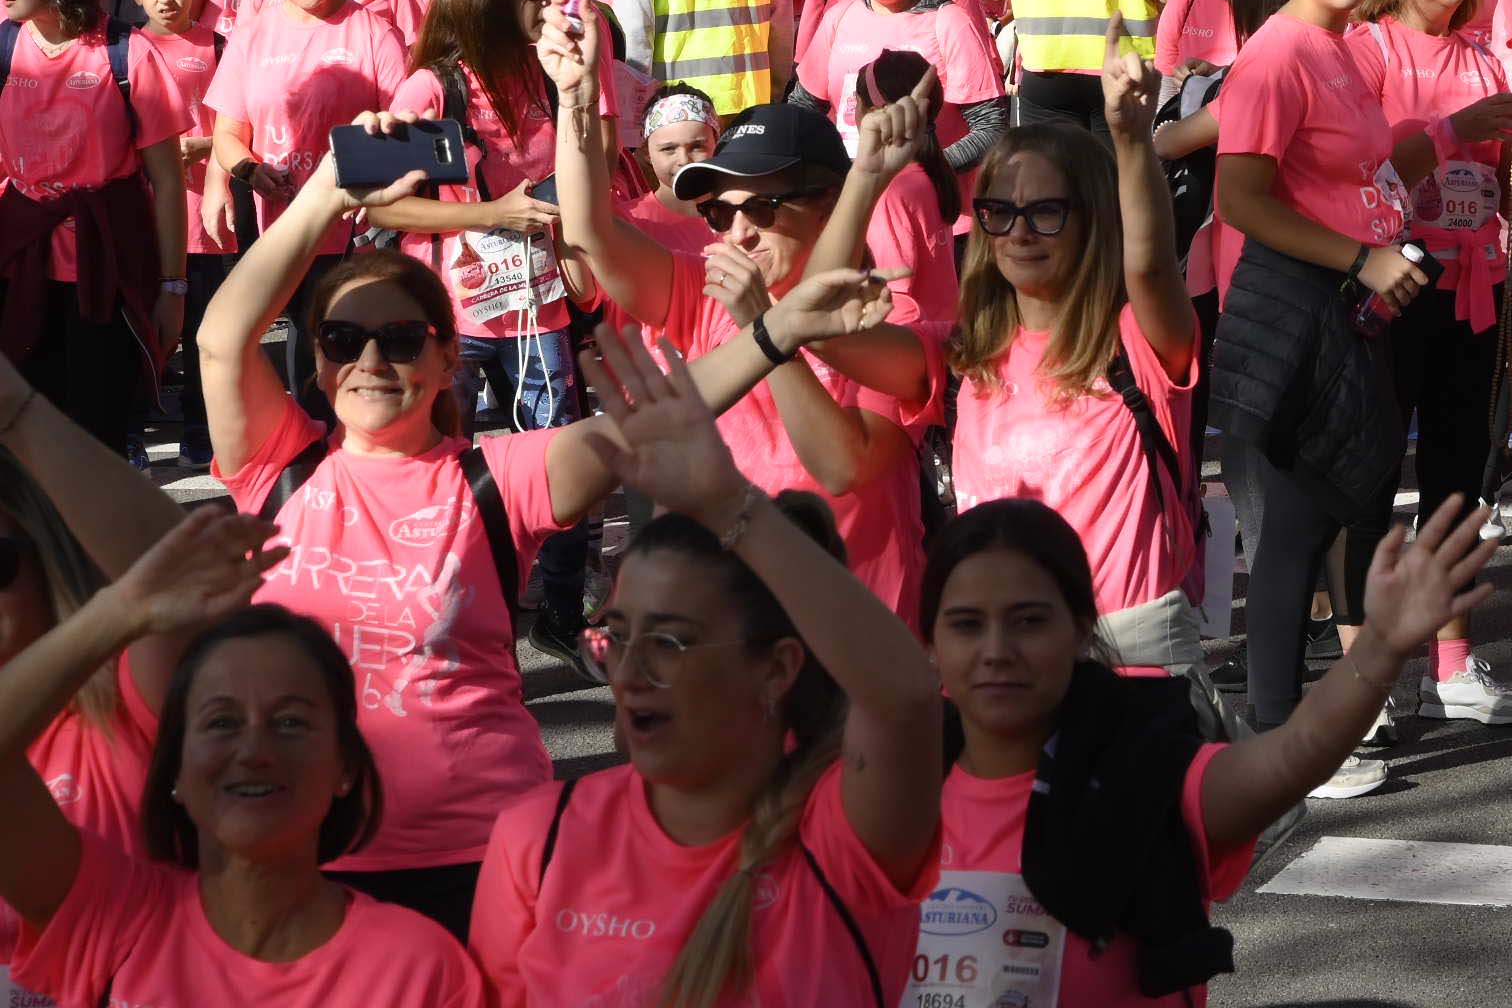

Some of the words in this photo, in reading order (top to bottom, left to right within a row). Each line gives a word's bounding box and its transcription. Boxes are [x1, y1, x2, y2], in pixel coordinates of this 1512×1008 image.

[262, 124, 288, 146] TU
[1446, 199, 1478, 215] 016
[1448, 217, 1473, 228] 24000
[487, 253, 524, 276] 016
[494, 272, 524, 286] 13540
[350, 600, 380, 625] DE
[384, 605, 417, 629] LA
[556, 907, 657, 940] OYSHO
[911, 953, 979, 984] 016
